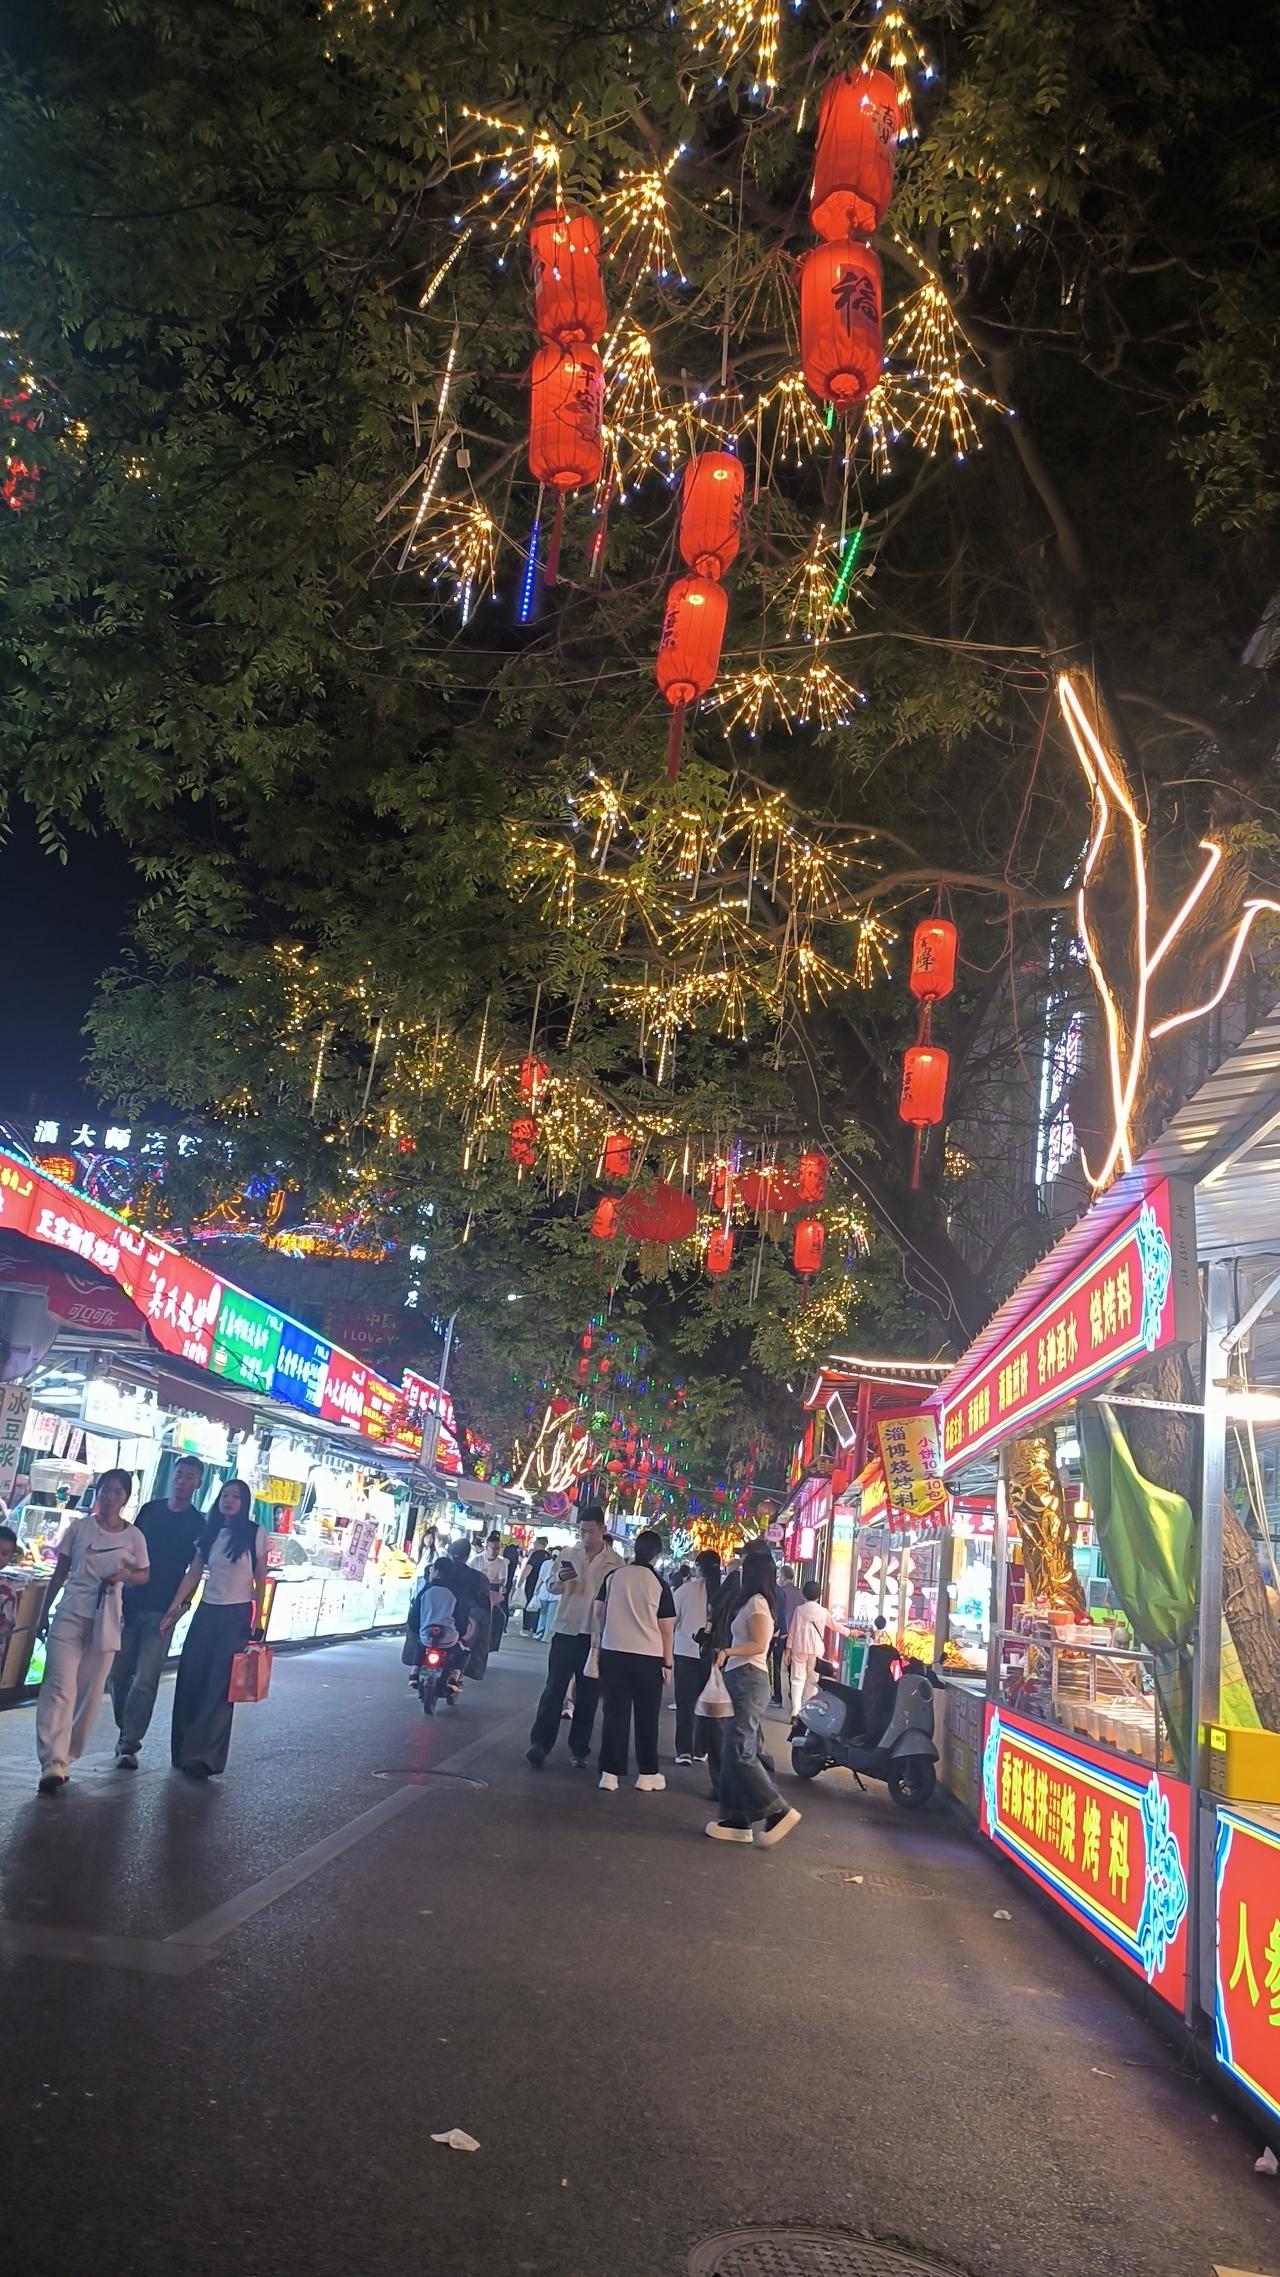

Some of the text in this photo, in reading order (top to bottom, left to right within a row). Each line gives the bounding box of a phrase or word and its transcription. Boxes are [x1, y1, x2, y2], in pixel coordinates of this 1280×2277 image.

[967, 1384, 991, 1437] 香酥烧饼
[1037, 1310, 1079, 1387] 各种酒水
[1089, 1261, 1133, 1350] 烧烤料
[0, 1391, 28, 1468] 冰豆浆
[883, 1426, 918, 1508] 淄博烧烤料
[917, 1436, 942, 1502] 小饼10元10包
[1001, 1751, 1048, 1842] 香酥烧饼
[1060, 1782, 1130, 1905] 烧烤料
